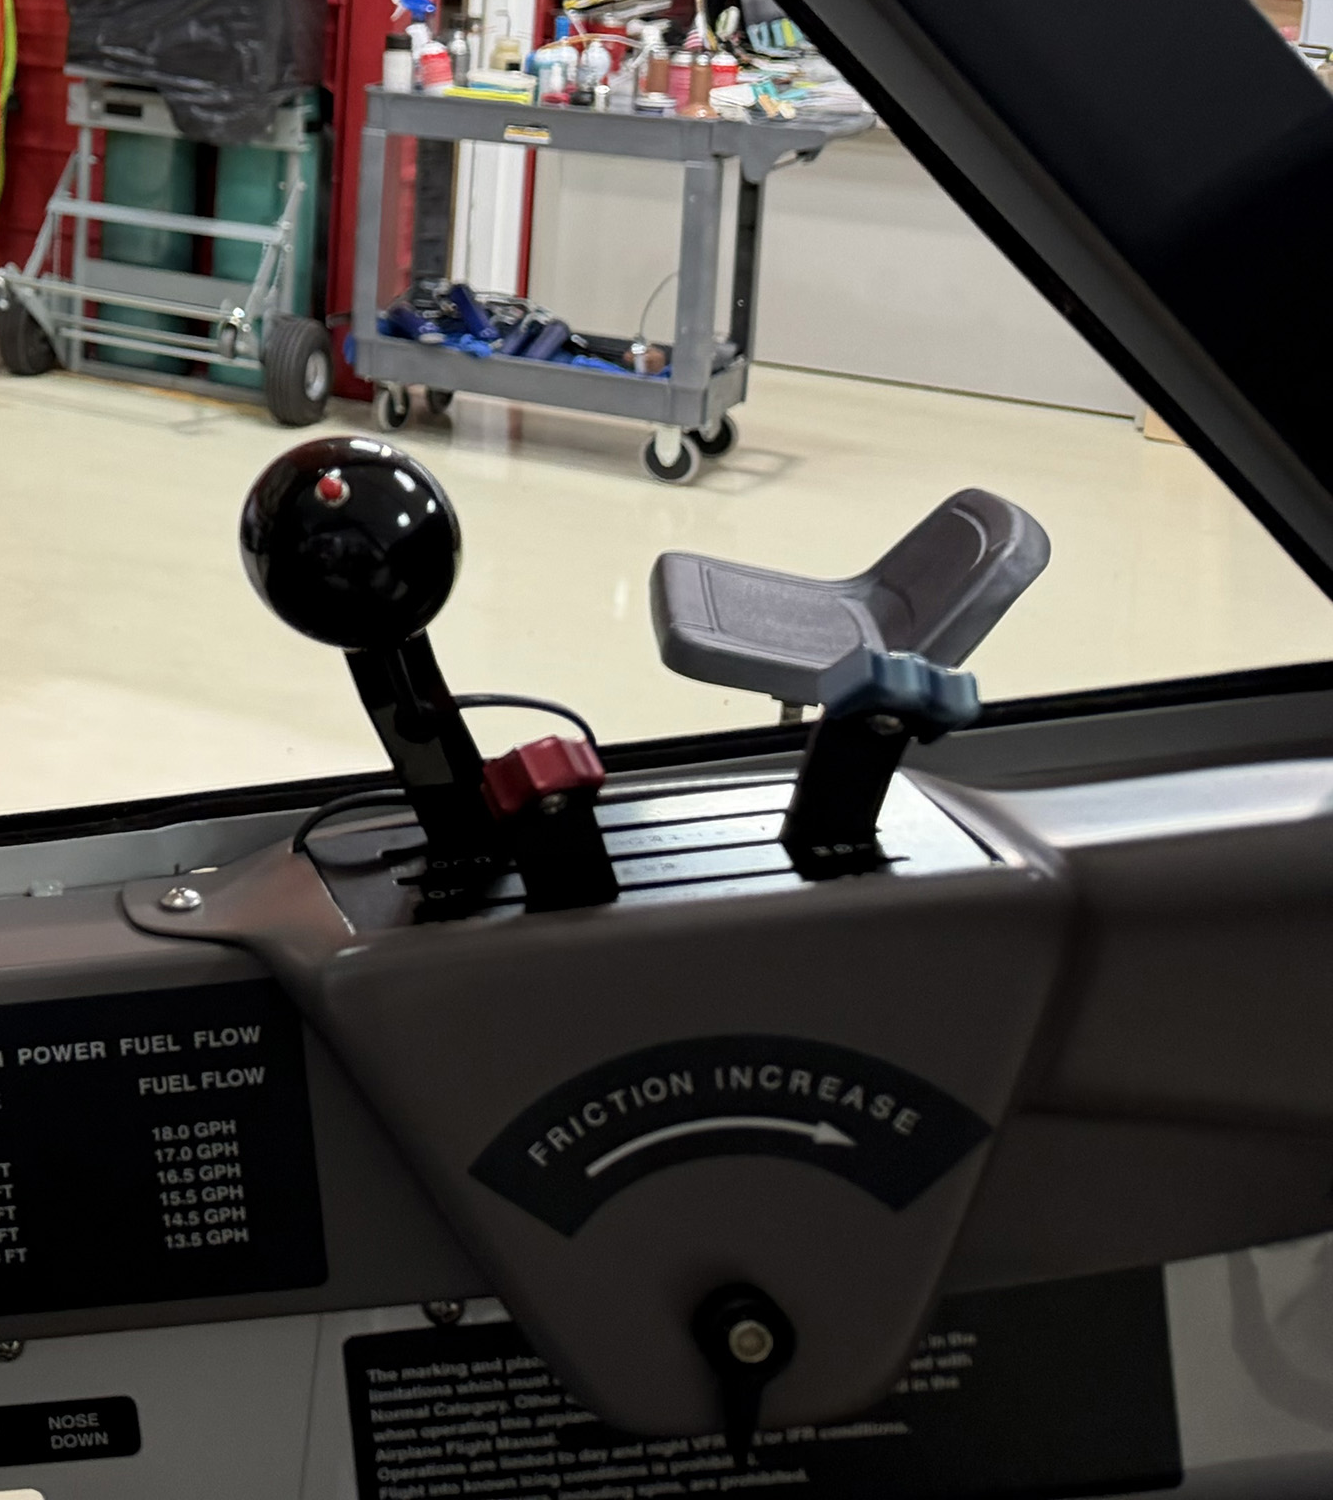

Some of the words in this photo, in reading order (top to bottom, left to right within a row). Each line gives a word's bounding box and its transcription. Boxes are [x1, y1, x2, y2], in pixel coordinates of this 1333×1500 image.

[17, 1041, 107, 1067] POWER
[119, 1033, 182, 1057] FUEL
[193, 1025, 262, 1049] FLOW
[138, 1075, 197, 1097] FUEL
[201, 1066, 266, 1090] FLOW
[527, 1071, 695, 1168] FRICTION
[714, 1064, 921, 1137] INCREASE
[152, 1125, 190, 1142] 18.0
[193, 1119, 237, 1139] GPH
[154, 1147, 193, 1163] 17.0
[197, 1140, 239, 1161] GPH
[157, 1168, 196, 1185] 16.5
[199, 1162, 242, 1182] GPH
[159, 1190, 198, 1207] 15.5
[202, 1185, 244, 1204] GPH
[161, 1211, 201, 1228] 14.5
[204, 1206, 246, 1225] GPH
[165, 1233, 203, 1250] 13.5
[206, 1228, 249, 1247] GPH
[0, 1247, 28, 1266] FT
[365, 1367, 399, 1384] The
[401, 1362, 469, 1381] marking
[470, 1357, 502, 1374] and
[368, 1383, 454, 1404] limitations
[455, 1377, 506, 1396] which
[507, 1373, 551, 1391] must
[370, 1404, 431, 1423] Normal
[432, 1399, 511, 1418] Category.
[513, 1392, 561, 1409] Other
[48, 1411, 99, 1431] NOSE
[372, 1427, 418, 1443] when
[419, 1419, 499, 1440] operating
[499, 1416, 532, 1431] this
[50, 1430, 108, 1450] DOWN
[375, 1443, 444, 1463] Airplane
[445, 1438, 493, 1458] Flight
[494, 1431, 561, 1450] Manual.
[376, 1461, 468, 1483] Operations
[468, 1458, 498, 1474] are
[499, 1451, 555, 1471] limited
[556, 1450, 577, 1466] to
[577, 1447, 609, 1464] day
[610, 1441, 644, 1460] and
[645, 1437, 690, 1458] night
[691, 1432, 727, 1451] VFR
[763, 1431, 784, 1446] or
[817, 1421, 913, 1441] conditions.
[379, 1483, 426, 1500] Flight
[427, 1482, 462, 1497] into
[462, 1476, 518, 1493] known
[518, 1472, 562, 1489] icing
[562, 1464, 650, 1484] conditions
[650, 1460, 668, 1476] is
[689, 1477, 718, 1492] are
